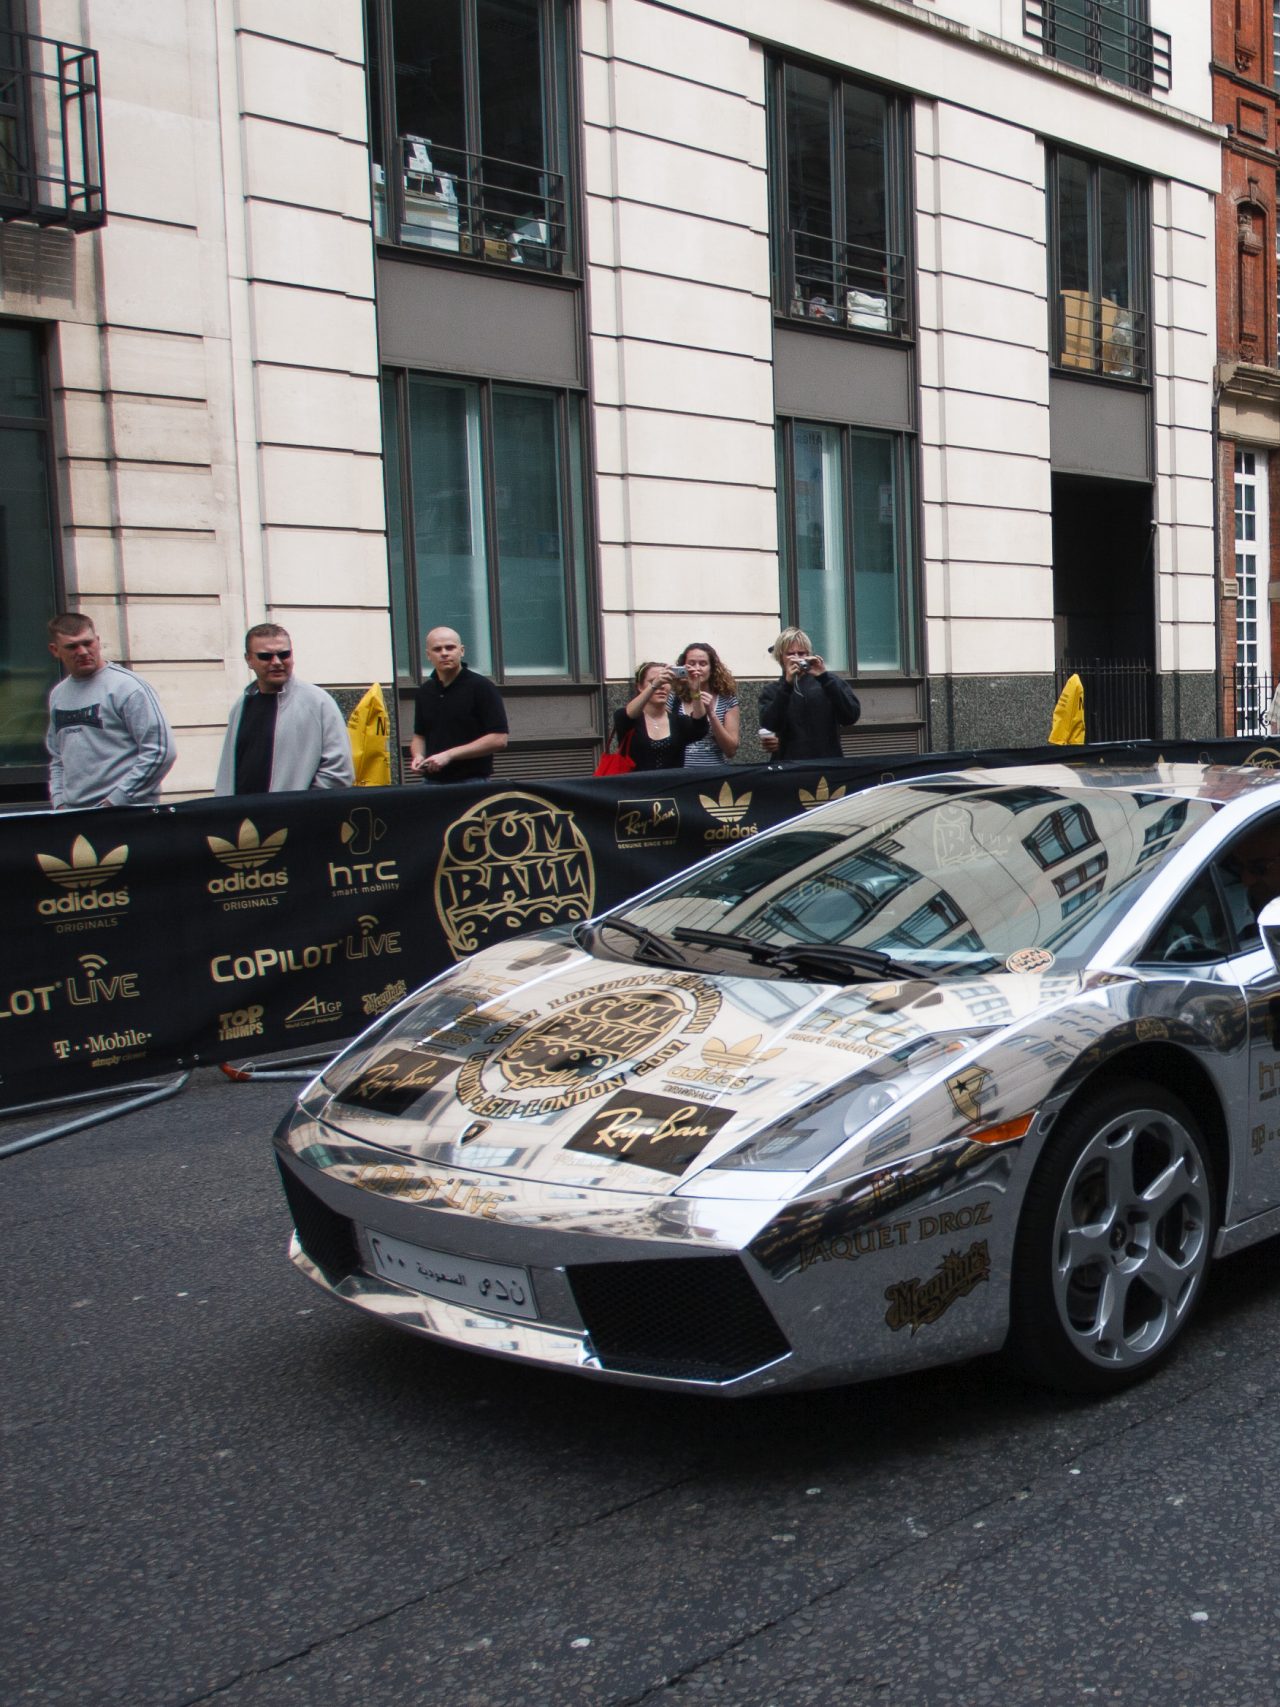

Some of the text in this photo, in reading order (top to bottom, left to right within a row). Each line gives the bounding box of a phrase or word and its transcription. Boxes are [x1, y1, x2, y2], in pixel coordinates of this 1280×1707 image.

[704, 823, 757, 840] adidas
[207, 867, 289, 894] adidas
[332, 882, 400, 897] smart mobility
[445, 853, 590, 912] BALL
[37, 887, 130, 915] adidas
[223, 897, 279, 911] ORIGINALS
[56, 918, 118, 933] ORIGINALS
[219, 1005, 264, 1030] TOP
[219, 1022, 264, 1041] TRUMPS
[666, 1065, 749, 1090] adidas
[798, 1201, 993, 1274] JAQUET DROZ
